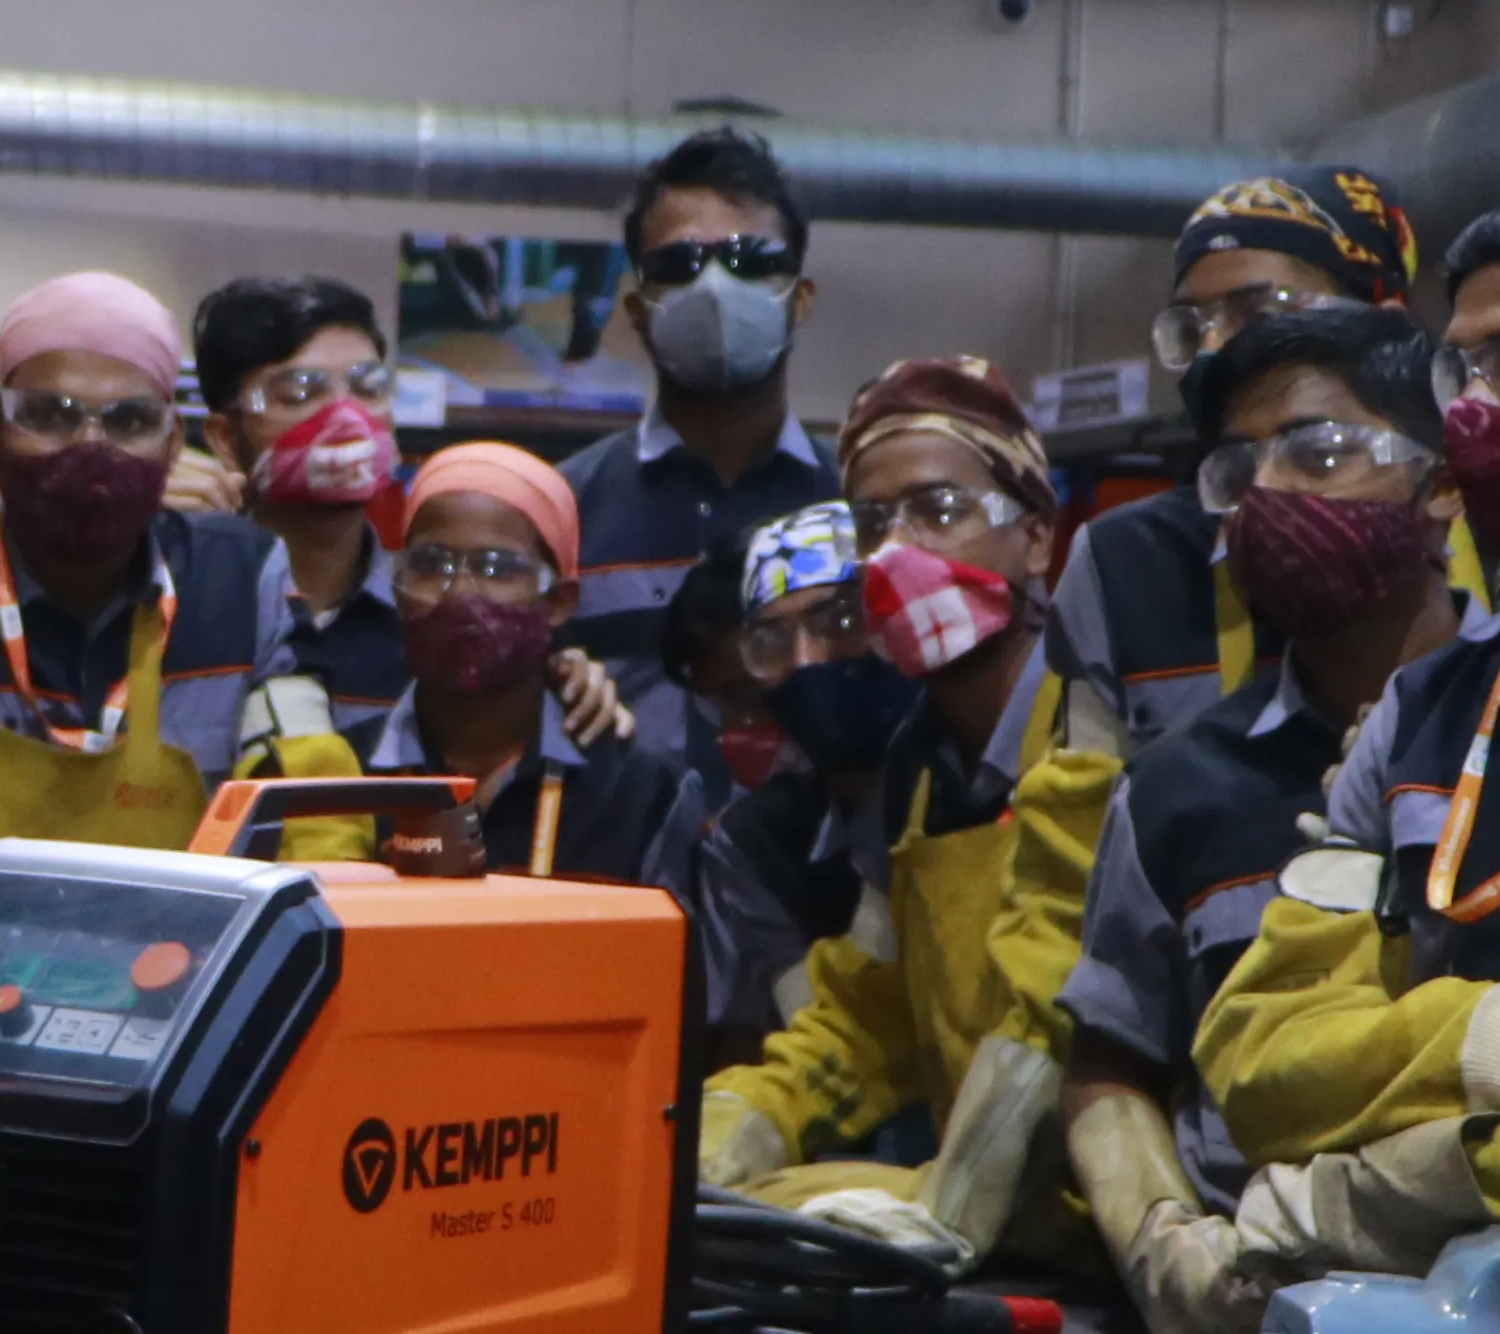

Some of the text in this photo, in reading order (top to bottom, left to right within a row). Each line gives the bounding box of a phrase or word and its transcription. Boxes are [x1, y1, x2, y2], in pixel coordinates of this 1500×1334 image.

[403, 1112, 559, 1192] KEMPPI
[431, 1197, 556, 1239] Master S 400
